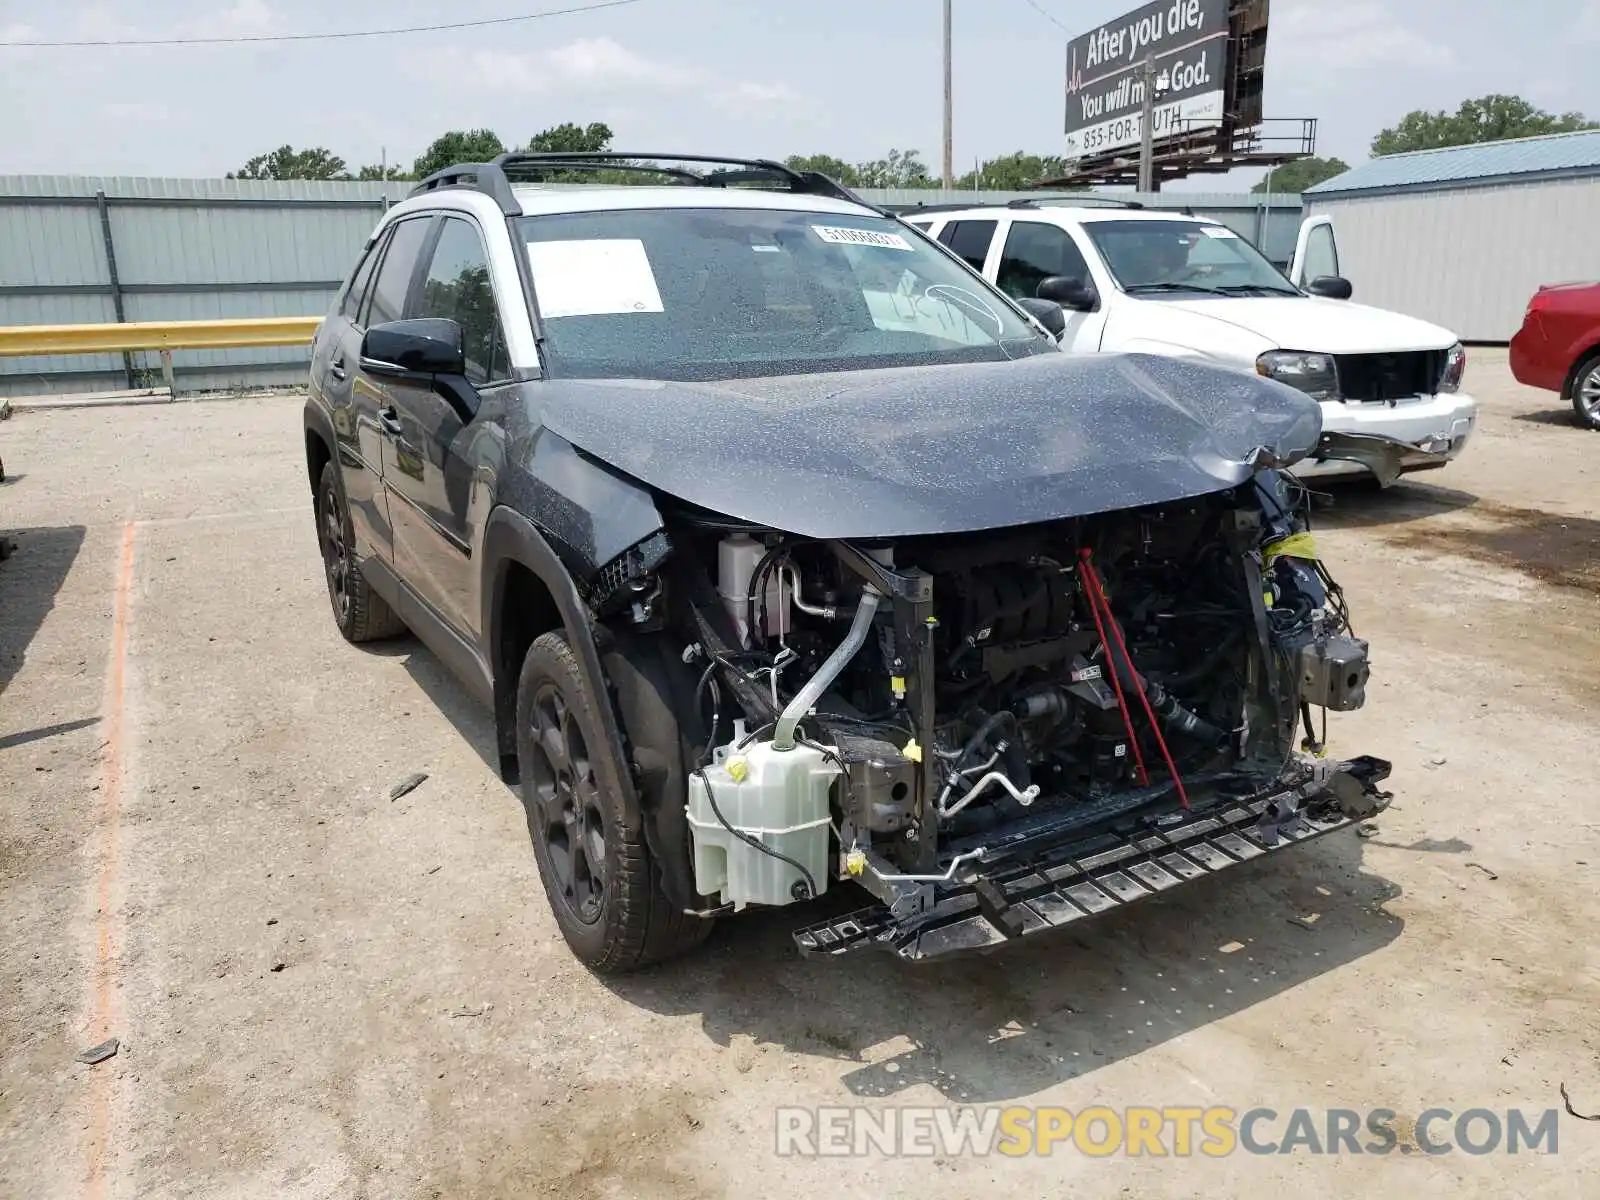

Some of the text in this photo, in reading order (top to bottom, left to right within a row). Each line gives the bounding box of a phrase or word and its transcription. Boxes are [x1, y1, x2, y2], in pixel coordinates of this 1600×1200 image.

[1086, 0, 1204, 69] After you die,
[1081, 92, 1103, 120] You
[1105, 77, 1131, 112] will
[1171, 50, 1210, 92] God.
[1083, 103, 1182, 150] 855-FOR-TUTH
